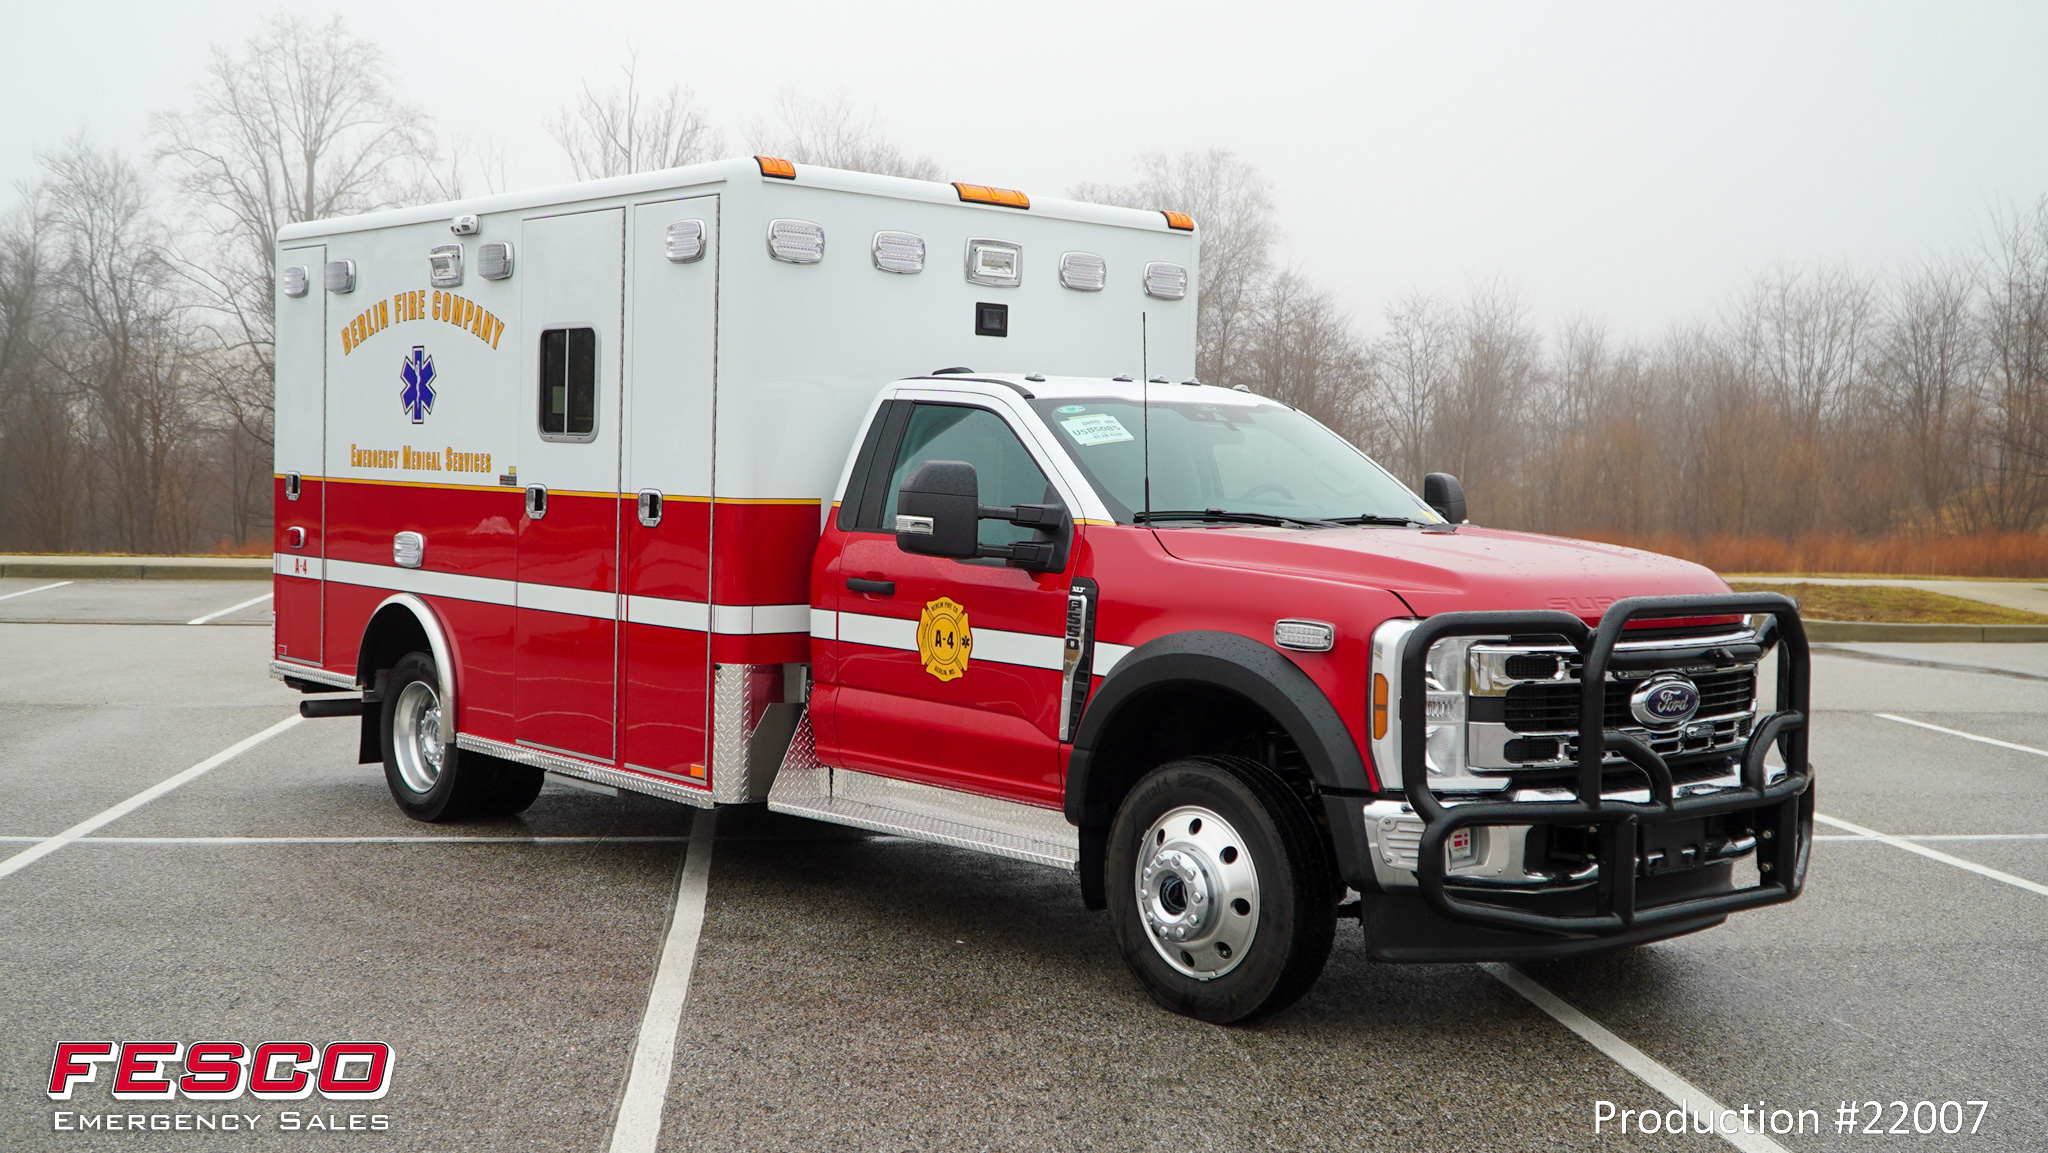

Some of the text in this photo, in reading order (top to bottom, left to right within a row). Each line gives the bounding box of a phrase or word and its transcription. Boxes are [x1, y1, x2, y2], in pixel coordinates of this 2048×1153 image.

[341, 290, 505, 356] BERLIN FIRE COMPANY
[351, 444, 492, 473] EMERGENCY MEDICAL SERVICES
[295, 558, 307, 575] A-4
[1066, 600, 1082, 650] F550
[935, 630, 954, 649] A-4
[1657, 689, 1689, 713] Ford
